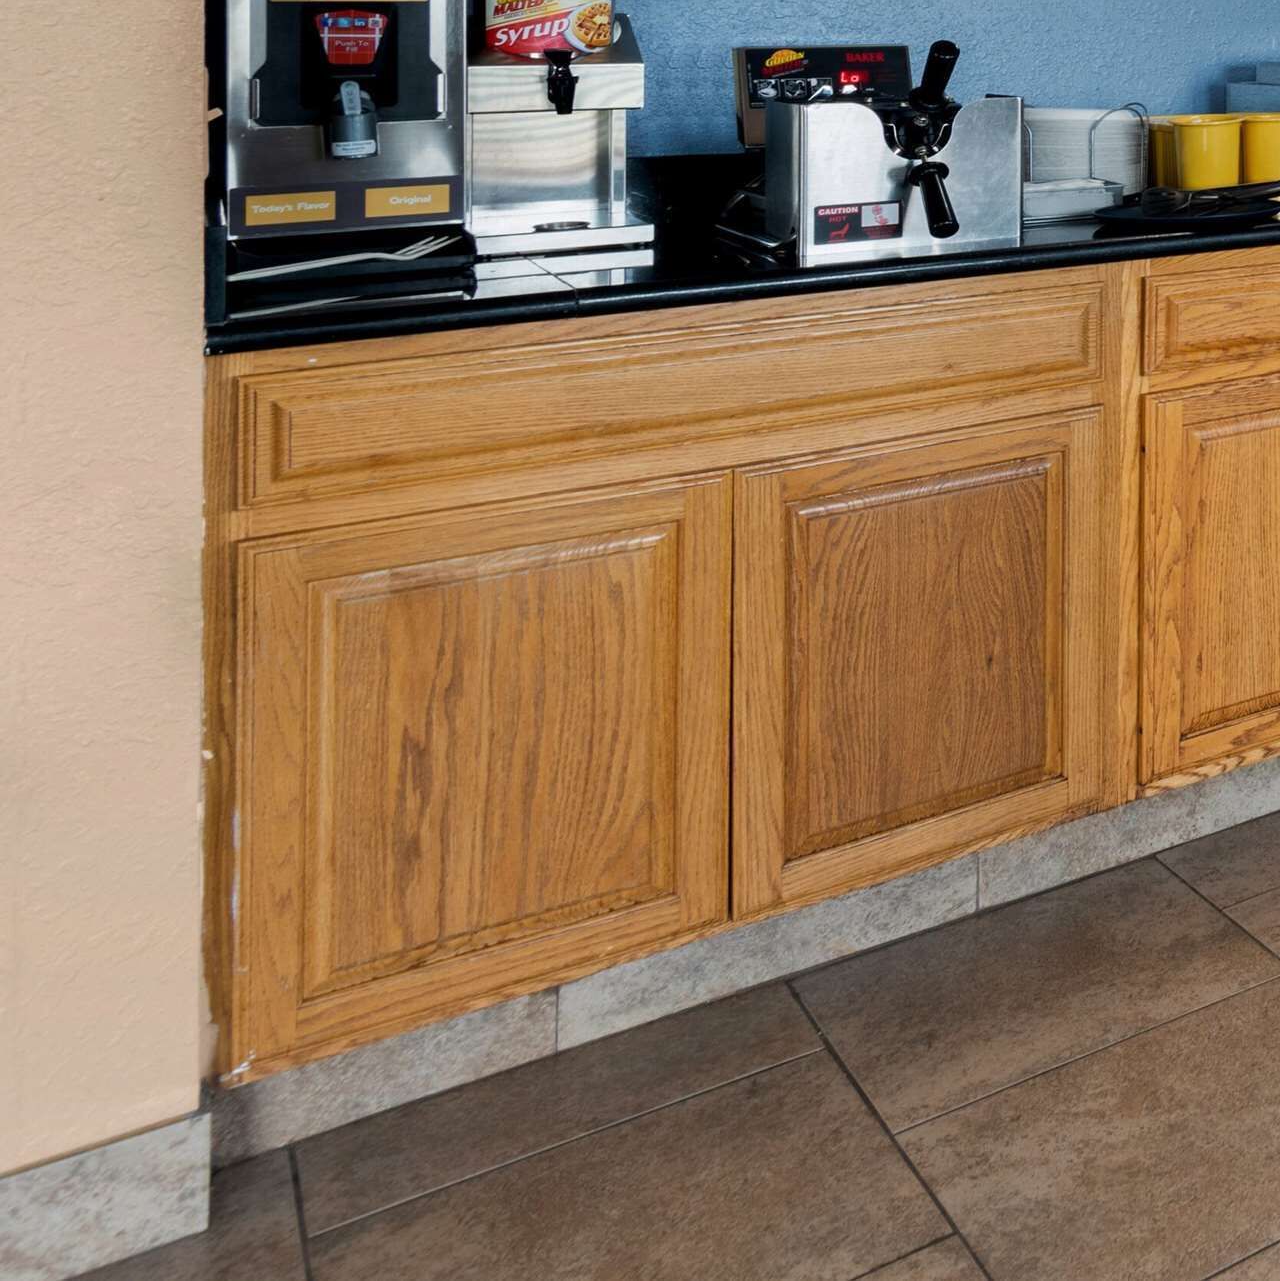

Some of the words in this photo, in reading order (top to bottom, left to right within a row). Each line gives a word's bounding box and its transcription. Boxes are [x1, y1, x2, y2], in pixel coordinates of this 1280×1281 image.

[494, 18, 569, 46] Syrup
[845, 52, 885, 63] BAKER
[389, 194, 432, 206] Original
[252, 204, 293, 214] Today's
[297, 201, 330, 211] Flavor
[818, 206, 858, 216] CAUTION
